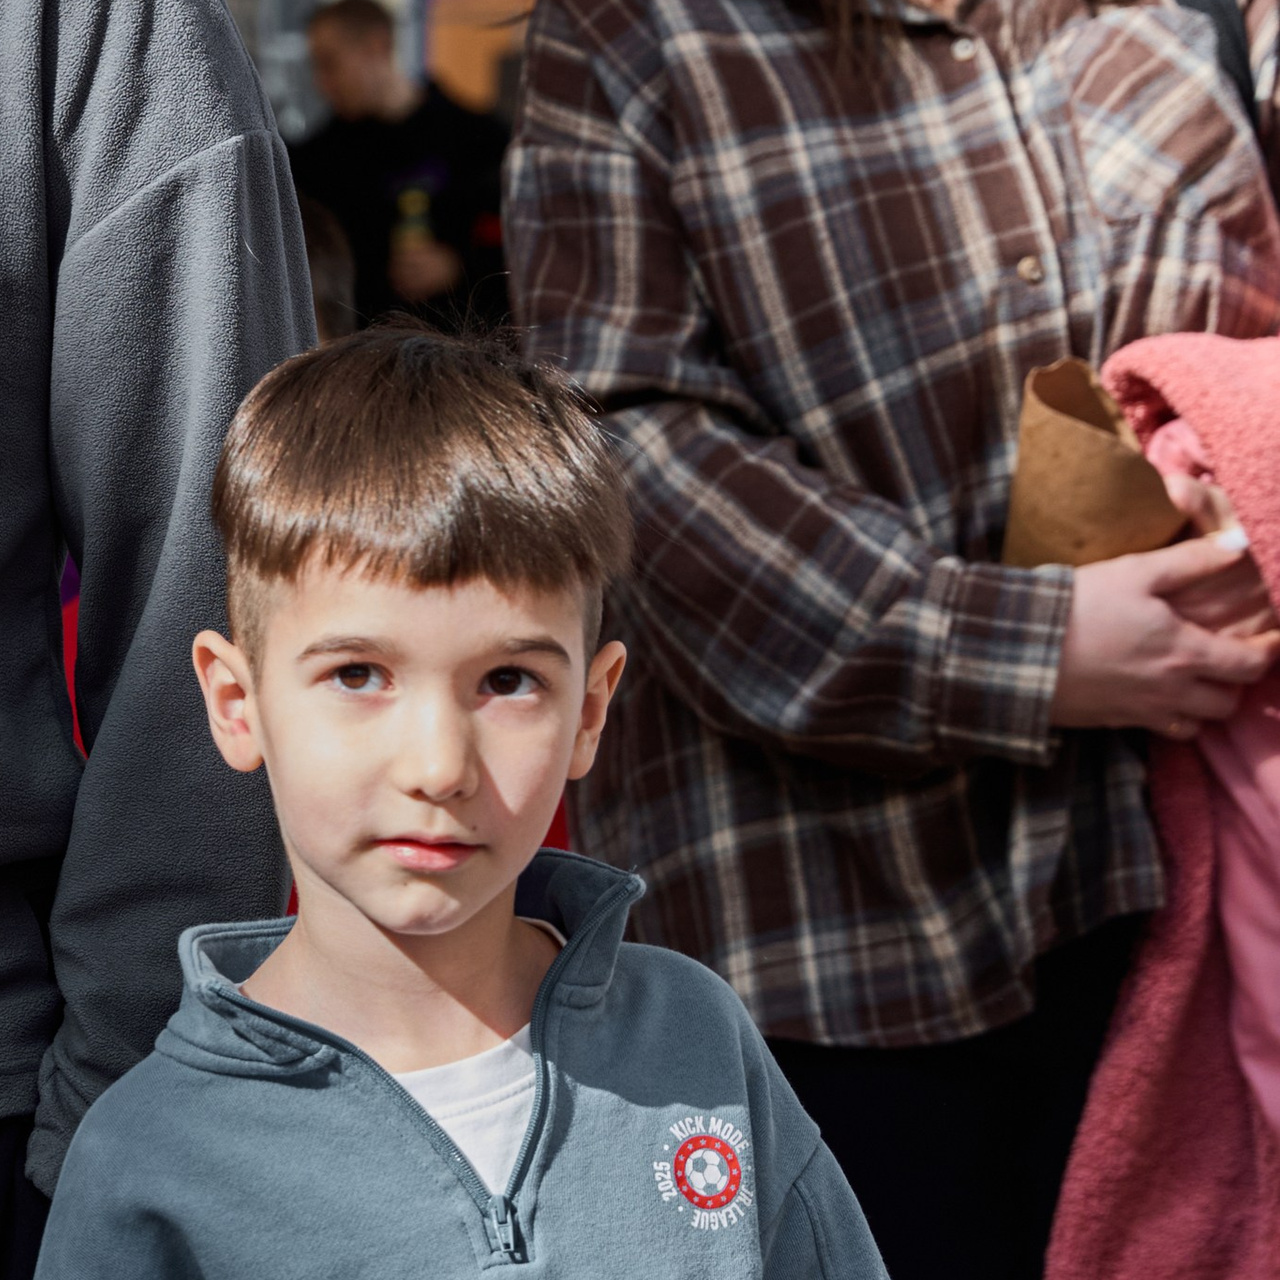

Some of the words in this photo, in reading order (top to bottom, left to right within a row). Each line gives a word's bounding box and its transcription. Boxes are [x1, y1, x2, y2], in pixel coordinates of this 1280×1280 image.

[670, 1116, 705, 1141] KICK
[708, 1117, 749, 1154] MODE
[653, 1161, 678, 1202] 2025
[691, 1202, 745, 1230] LEAGUE
